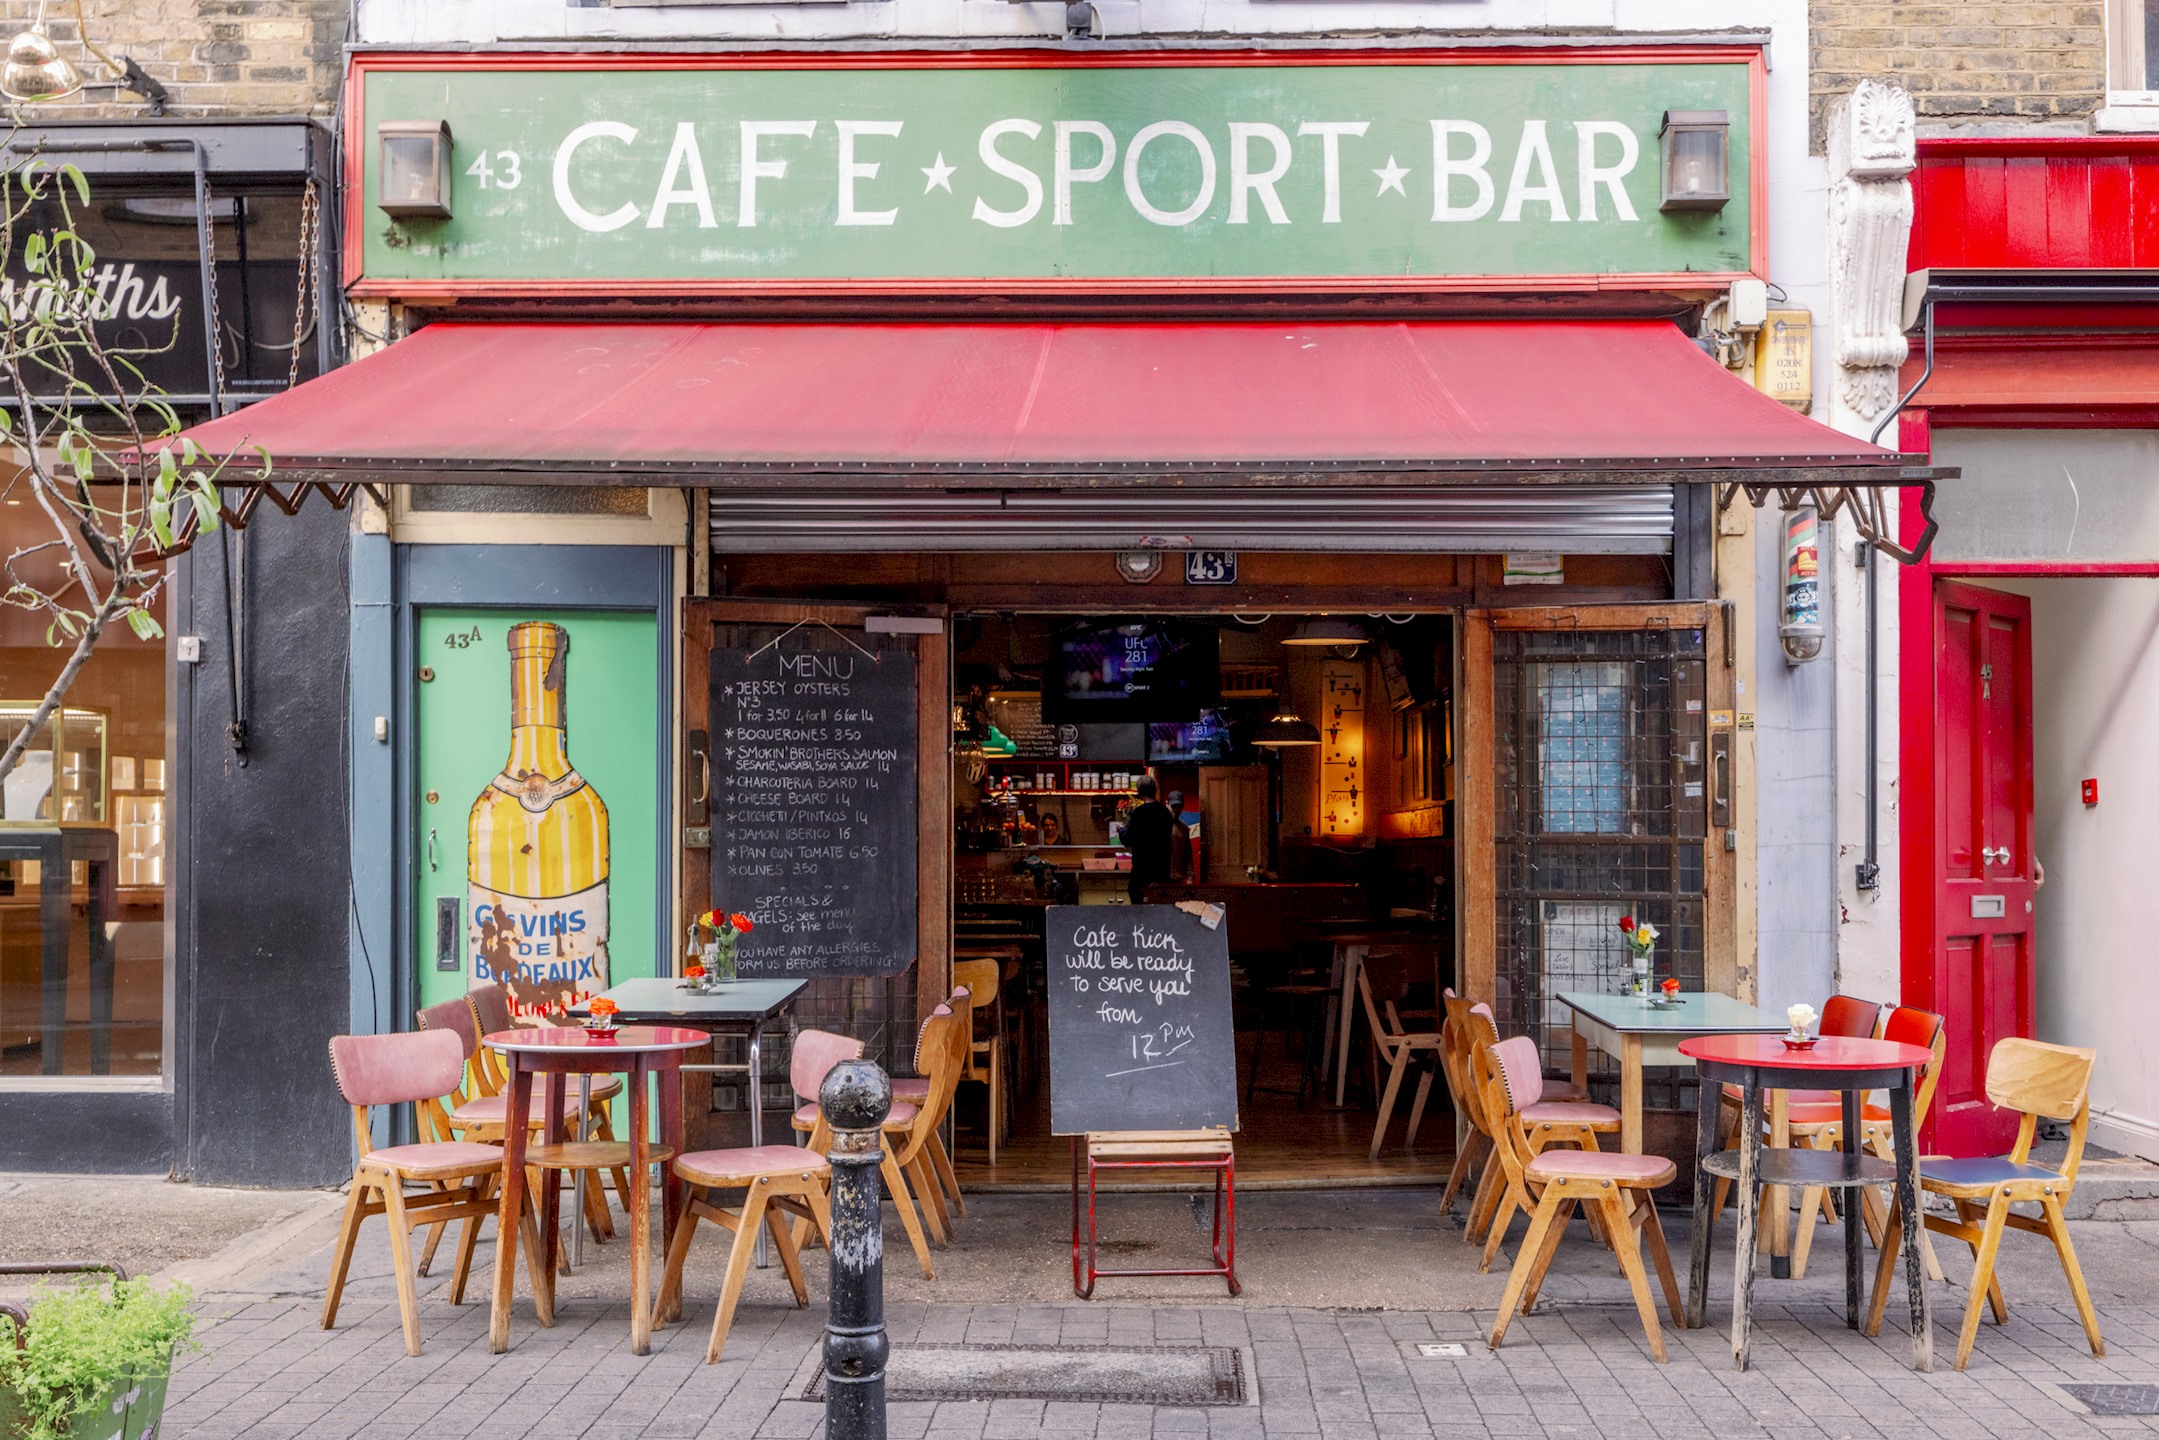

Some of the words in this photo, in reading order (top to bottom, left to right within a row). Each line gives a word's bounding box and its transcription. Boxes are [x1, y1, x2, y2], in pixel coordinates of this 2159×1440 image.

[464, 150, 523, 190] 43
[552, 119, 905, 233] CAFE
[971, 118, 1371, 227] SPORT
[1430, 118, 1640, 223] BAR
[1777, 359, 1801, 367] 0208
[1780, 371, 1798, 379] 524
[1189, 550, 1224, 580] 43
[1125, 650, 1147, 663] 281
[779, 654, 854, 680] MENU
[736, 681, 786, 696] JERSEY
[793, 682, 850, 696] OYSTERS
[747, 709, 763, 722] for
[766, 709, 790, 721] 3.50
[805, 709, 820, 721] for
[834, 709, 842, 721] 6
[844, 709, 858, 721] for
[861, 709, 874, 723] 14
[737, 728, 828, 741] BOQUERONES
[1192, 725, 1208, 735] 281
[789, 747, 850, 761] BROTHERS
[852, 749, 897, 761] SALMON
[815, 761, 838, 771] SOYA
[840, 760, 869, 771] SAUCE
[877, 761, 890, 773] 14
[818, 776, 857, 789] BOARD
[865, 777, 879, 790] 14
[737, 793, 782, 806] CHEESE
[788, 792, 828, 804] BOARD
[836, 793, 850, 806] 14
[798, 810, 847, 823] PINTXOS
[855, 810, 868, 824] 14
[738, 828, 779, 841] JAMON
[785, 828, 831, 840] IBERICO
[839, 827, 851, 840] 16
[740, 845, 766, 859] PAN
[770, 847, 793, 859] CON
[798, 845, 844, 859] TOMATE
[739, 864, 784, 876] OLIVES
[754, 895, 819, 909] SPECIALS
[821, 894, 833, 907] &
[520, 909, 586, 937] VINS
[782, 921, 795, 933] of
[800, 921, 821, 932] the
[1132, 923, 1185, 952] Kick
[518, 943, 550, 956] DE
[757, 945, 786, 957] HAVE
[790, 945, 813, 956] ANY
[766, 961, 780, 970] US
[786, 957, 828, 970] BEFORE
[1065, 950, 1105, 970] will
[1110, 951, 1134, 970] be
[1137, 952, 1195, 984] ready
[1098, 975, 1144, 993] serve
[1150, 983, 1191, 1005] you
[1096, 1001, 1143, 1024] from
[1132, 1034, 1161, 1060] 12
